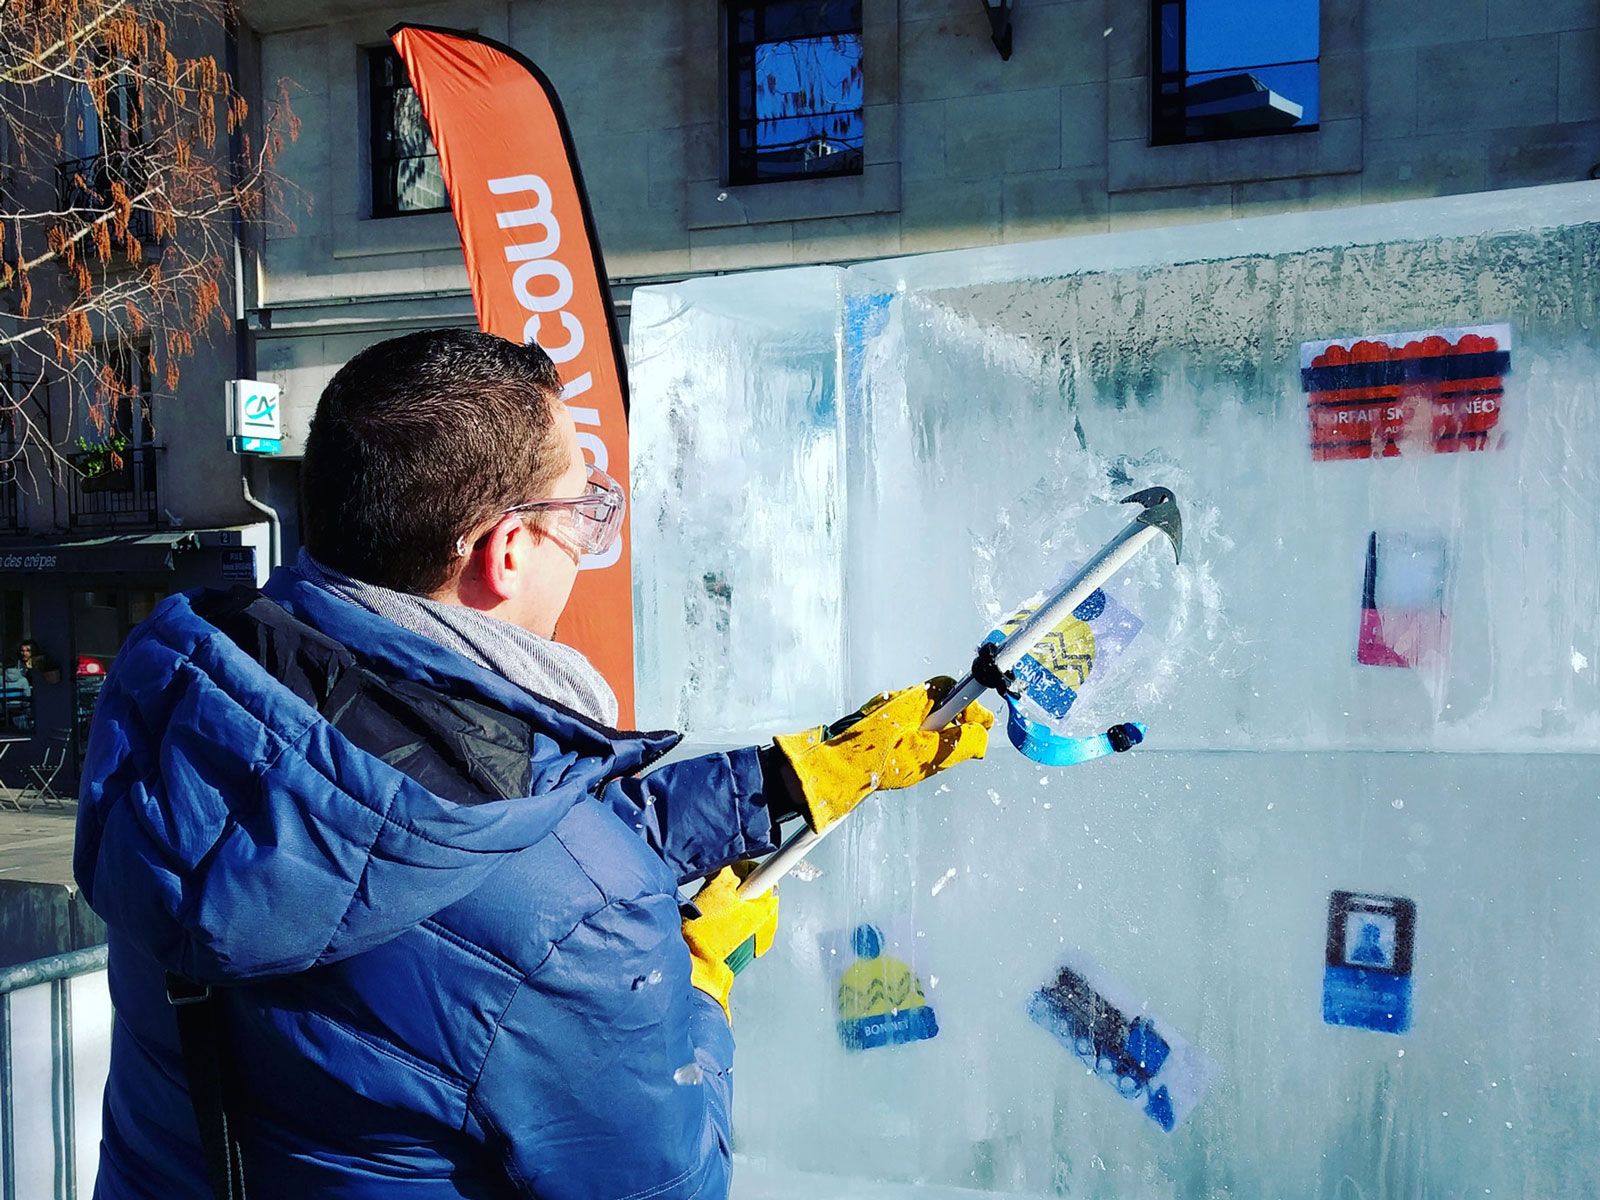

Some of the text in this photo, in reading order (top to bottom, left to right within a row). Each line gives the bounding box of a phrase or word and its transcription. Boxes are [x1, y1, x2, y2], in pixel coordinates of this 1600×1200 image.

[222, 532, 228, 543] 2
[4, 553, 23, 568] des
[24, 552, 57, 570] crêpes
[1013, 660, 1054, 693] ONNET
